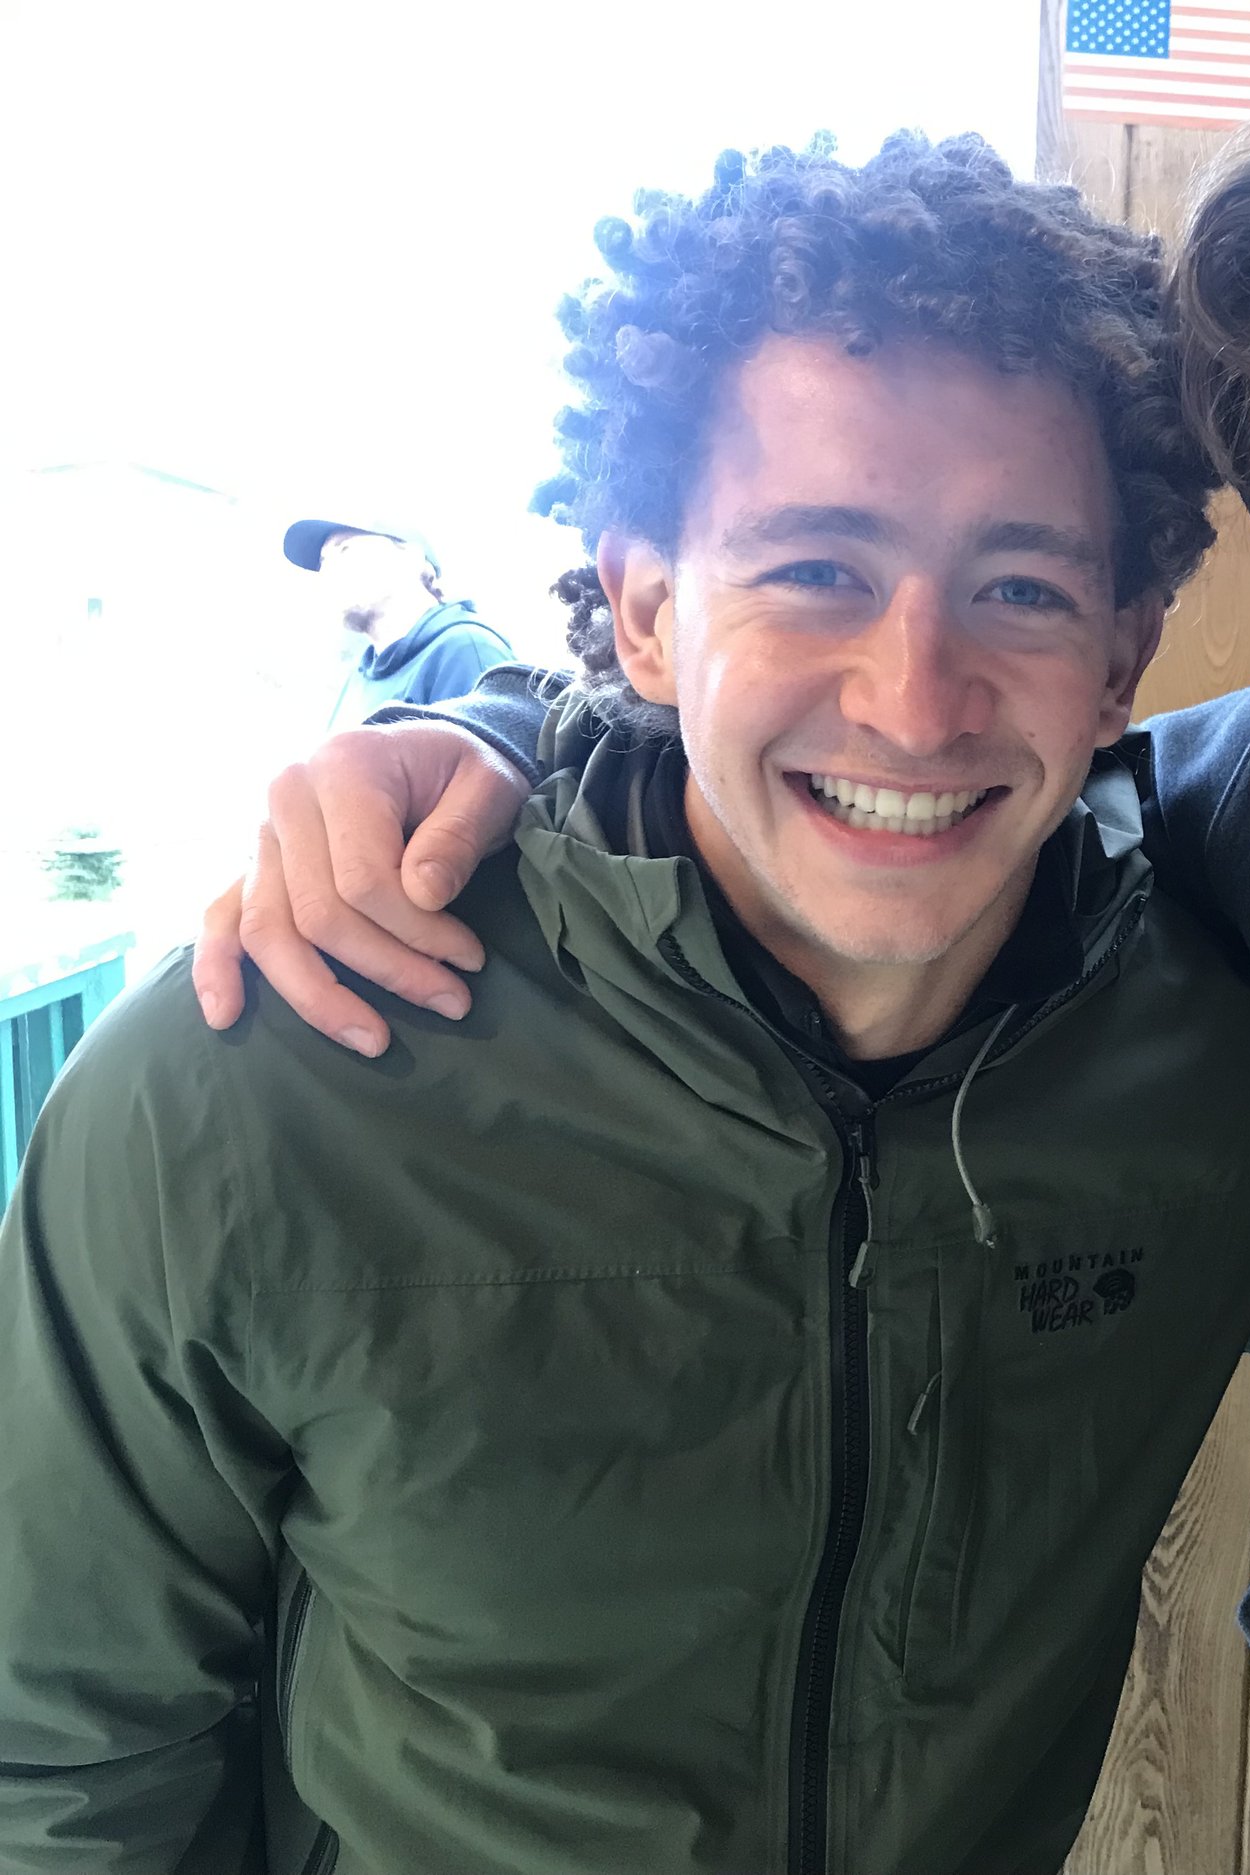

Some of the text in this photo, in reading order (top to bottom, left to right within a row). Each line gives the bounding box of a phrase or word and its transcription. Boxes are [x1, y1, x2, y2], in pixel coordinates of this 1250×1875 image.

[1014, 1247, 1144, 1281] MOUNTAIN
[1019, 1275, 1080, 1313] HARD
[1031, 1299, 1095, 1334] WEAR
